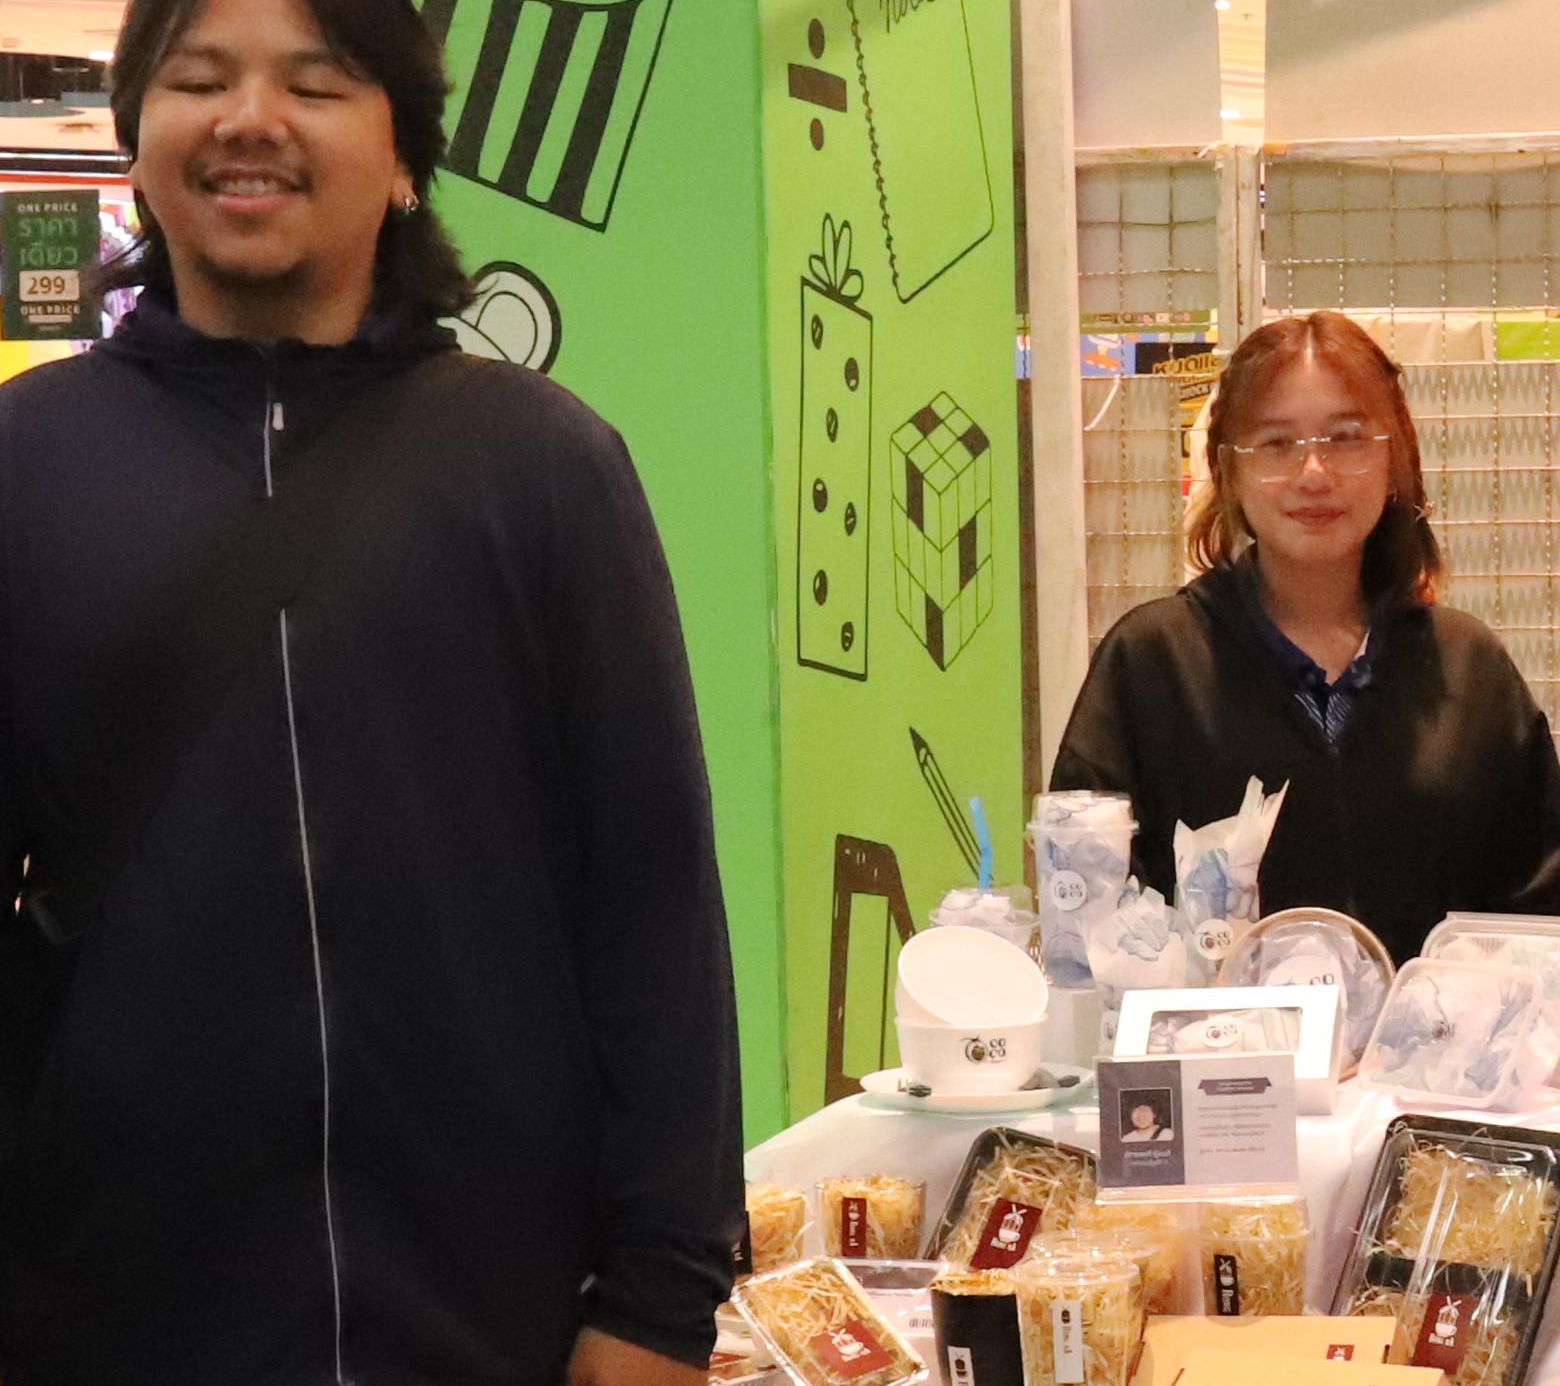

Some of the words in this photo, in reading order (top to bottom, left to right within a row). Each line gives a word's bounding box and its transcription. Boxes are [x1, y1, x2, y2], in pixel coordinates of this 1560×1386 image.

[17, 203, 40, 213] ONE
[44, 202, 78, 213] PRICE
[27, 276, 66, 295] 299
